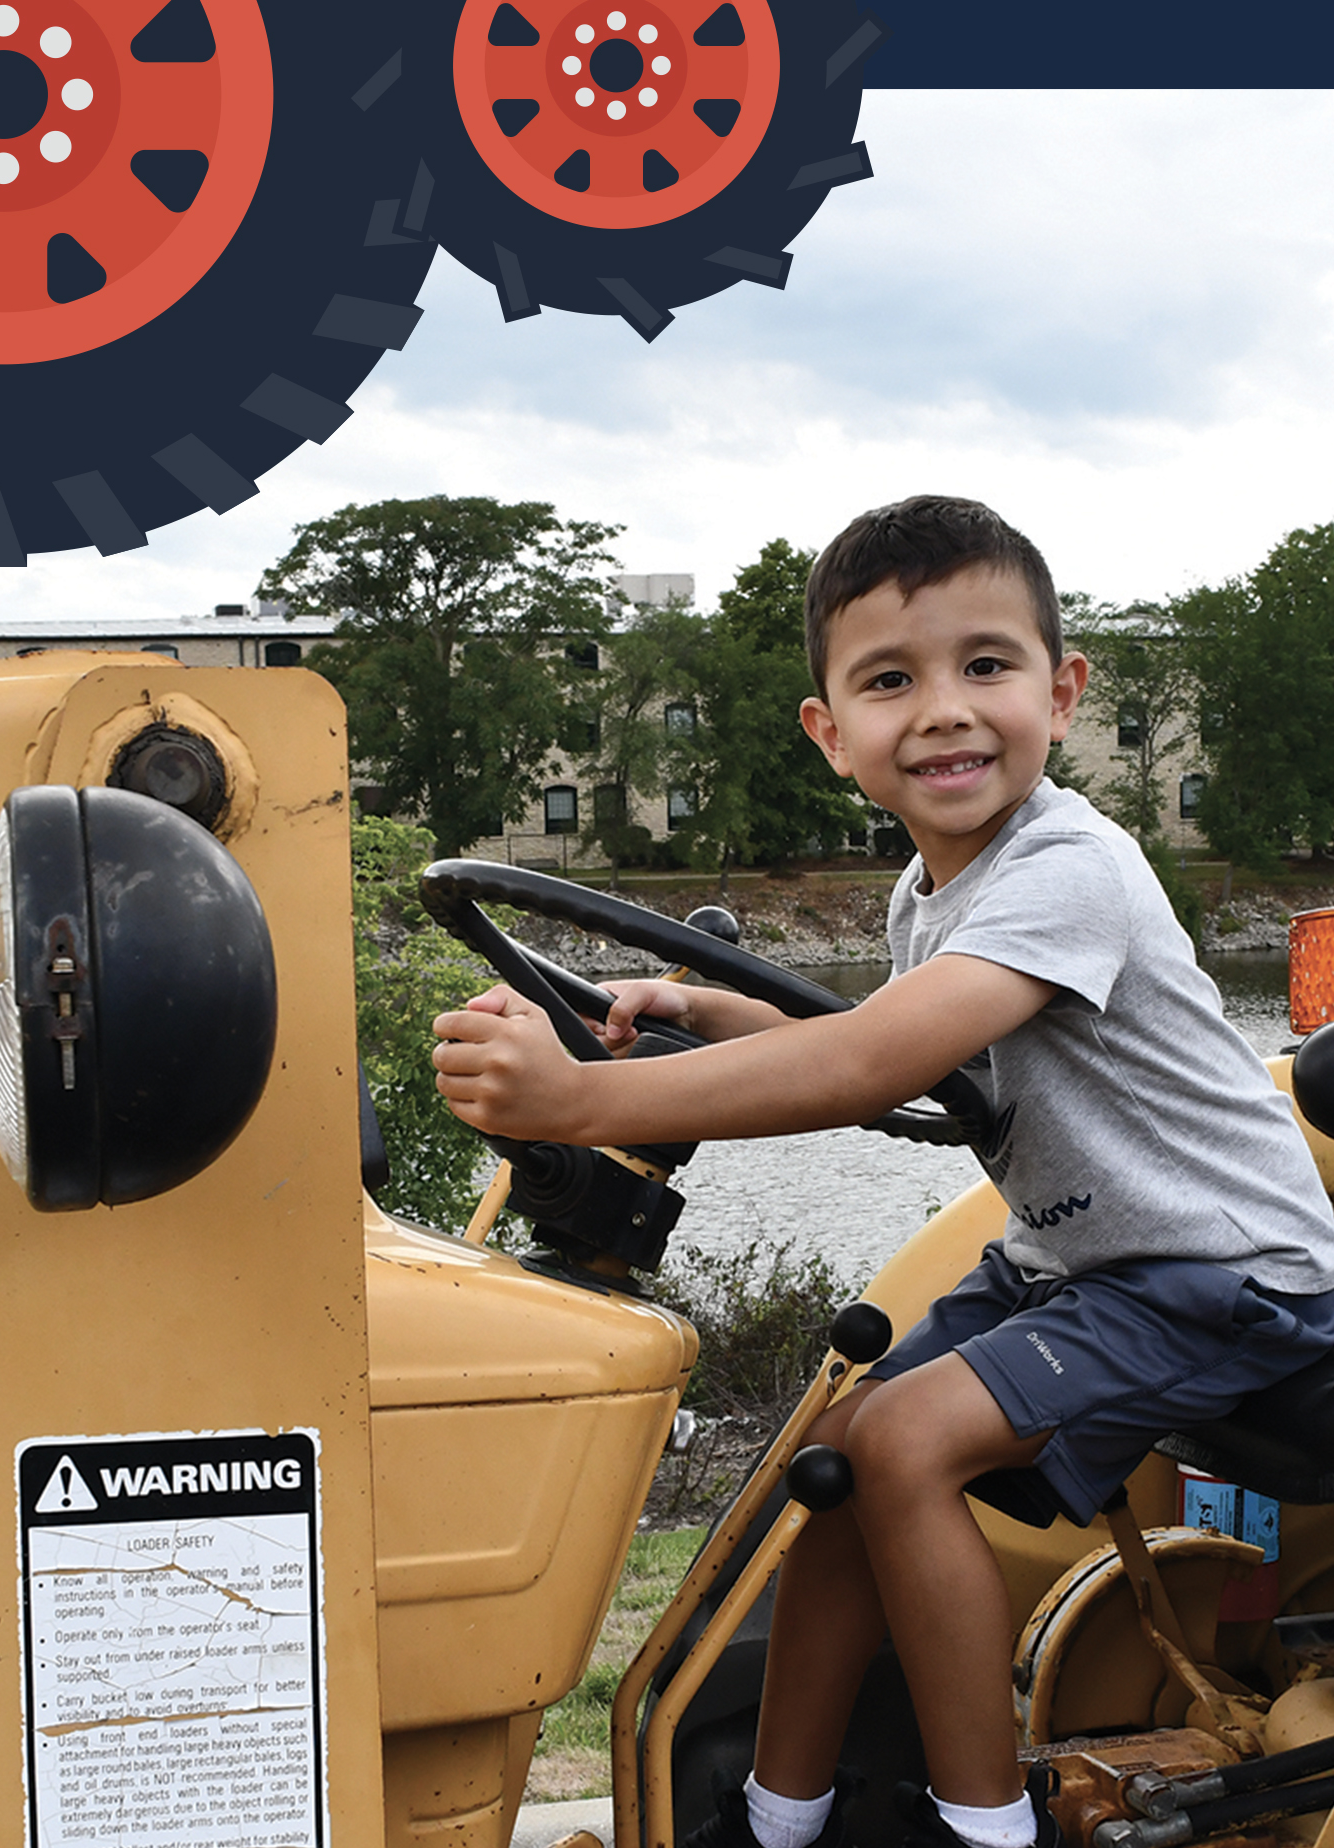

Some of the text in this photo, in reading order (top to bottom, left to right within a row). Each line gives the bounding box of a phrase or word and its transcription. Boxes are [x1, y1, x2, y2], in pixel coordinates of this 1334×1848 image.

[1026, 1331, 1064, 1375] DriWorks
[100, 1458, 301, 1497] WARNING
[127, 1535, 214, 1552] LOADER SAFETY
[54, 1576, 83, 1587] Know
[96, 1573, 108, 1585] all
[187, 1567, 228, 1579] warning
[241, 1565, 260, 1576] and
[273, 1562, 304, 1575] safety
[54, 1589, 117, 1602] instructions
[123, 1587, 134, 1598] in
[141, 1586, 158, 1597] the
[227, 1580, 264, 1591] manual
[271, 1578, 304, 1590] before
[55, 1630, 98, 1644] Operate
[102, 1628, 123, 1640] only
[129, 1626, 153, 1638] from
[158, 1625, 175, 1636] the
[180, 1621, 232, 1636] operator's
[55, 1641, 305, 1668] Stay out from under raised loader arms unless
[57, 1680, 306, 1708] Carry bucket low during transport for better
[57, 1709, 100, 1721] visibility
[106, 1707, 124, 1719] and
[146, 1703, 172, 1715] avoid
[58, 1718, 307, 1748] Using front end loaders without special
[59, 1733, 308, 1762] attachment for handling large heavy objects such
[59, 1768, 72, 1778] as
[73, 1764, 99, 1777] large
[102, 1761, 132, 1774] round
[166, 1757, 193, 1771] large
[194, 1753, 252, 1767] rectangular
[286, 1748, 308, 1761] logs
[60, 1780, 80, 1793] and
[84, 1779, 98, 1791] oil
[141, 1775, 150, 1786] is
[154, 1772, 176, 1785] NOT
[263, 1764, 308, 1776] Handling
[60, 1778, 308, 1810] large heavy objects with the loader can be
[61, 1808, 112, 1823] extremely
[173, 1802, 193, 1815] due
[196, 1801, 207, 1812] to
[209, 1800, 226, 1811] the
[229, 1797, 262, 1811] object
[264, 1794, 296, 1807] rolling
[298, 1794, 309, 1804] or
[62, 1826, 96, 1839] sliding
[99, 1823, 128, 1835] down
[131, 1821, 149, 1833] the
[152, 1818, 185, 1831] loader
[187, 1816, 214, 1828] arms
[217, 1814, 240, 1826] onto
[243, 1812, 260, 1824] the
[217, 1836, 251, 1848] weight
[253, 1835, 268, 1846] for
[270, 1831, 309, 1845] stability
